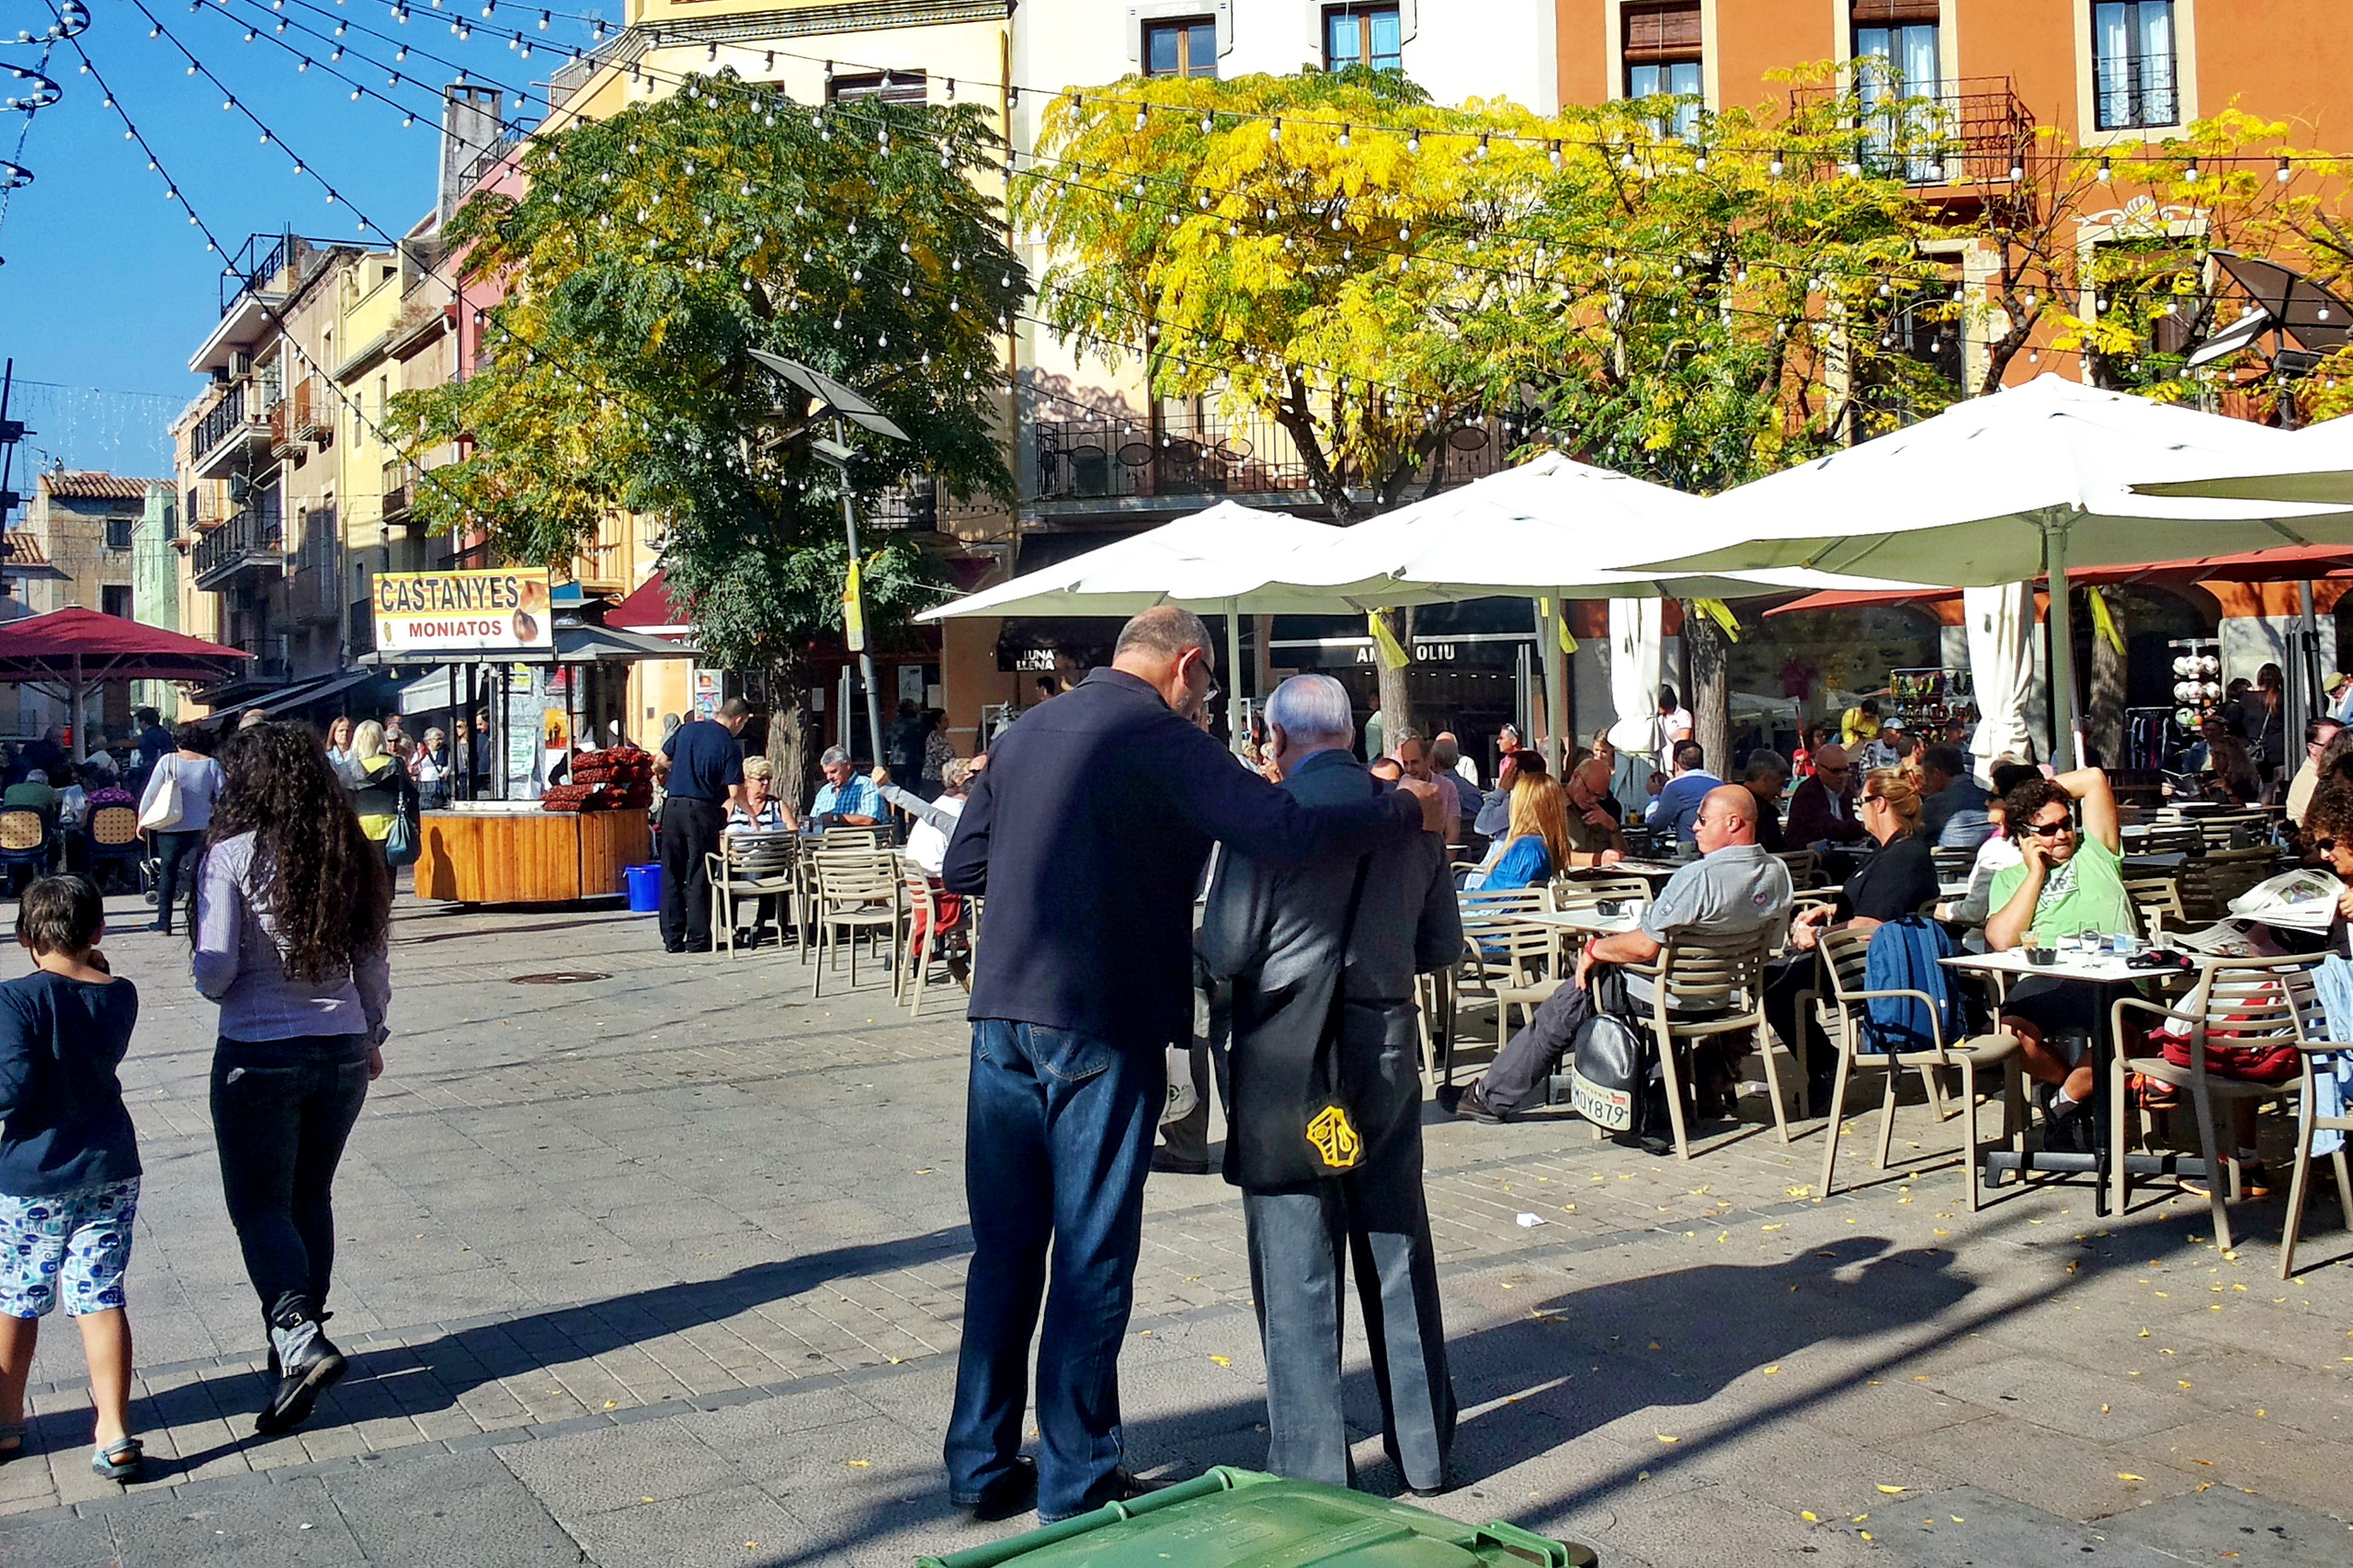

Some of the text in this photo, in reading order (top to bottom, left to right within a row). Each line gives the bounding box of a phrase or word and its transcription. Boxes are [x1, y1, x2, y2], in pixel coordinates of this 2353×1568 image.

[380, 574, 519, 612] CASTANYES
[409, 620, 502, 638] MONIATOS
[1023, 649, 1055, 660] LUNA
[1415, 644, 1455, 661] OLIU
[1016, 660, 1055, 671] LLENA
